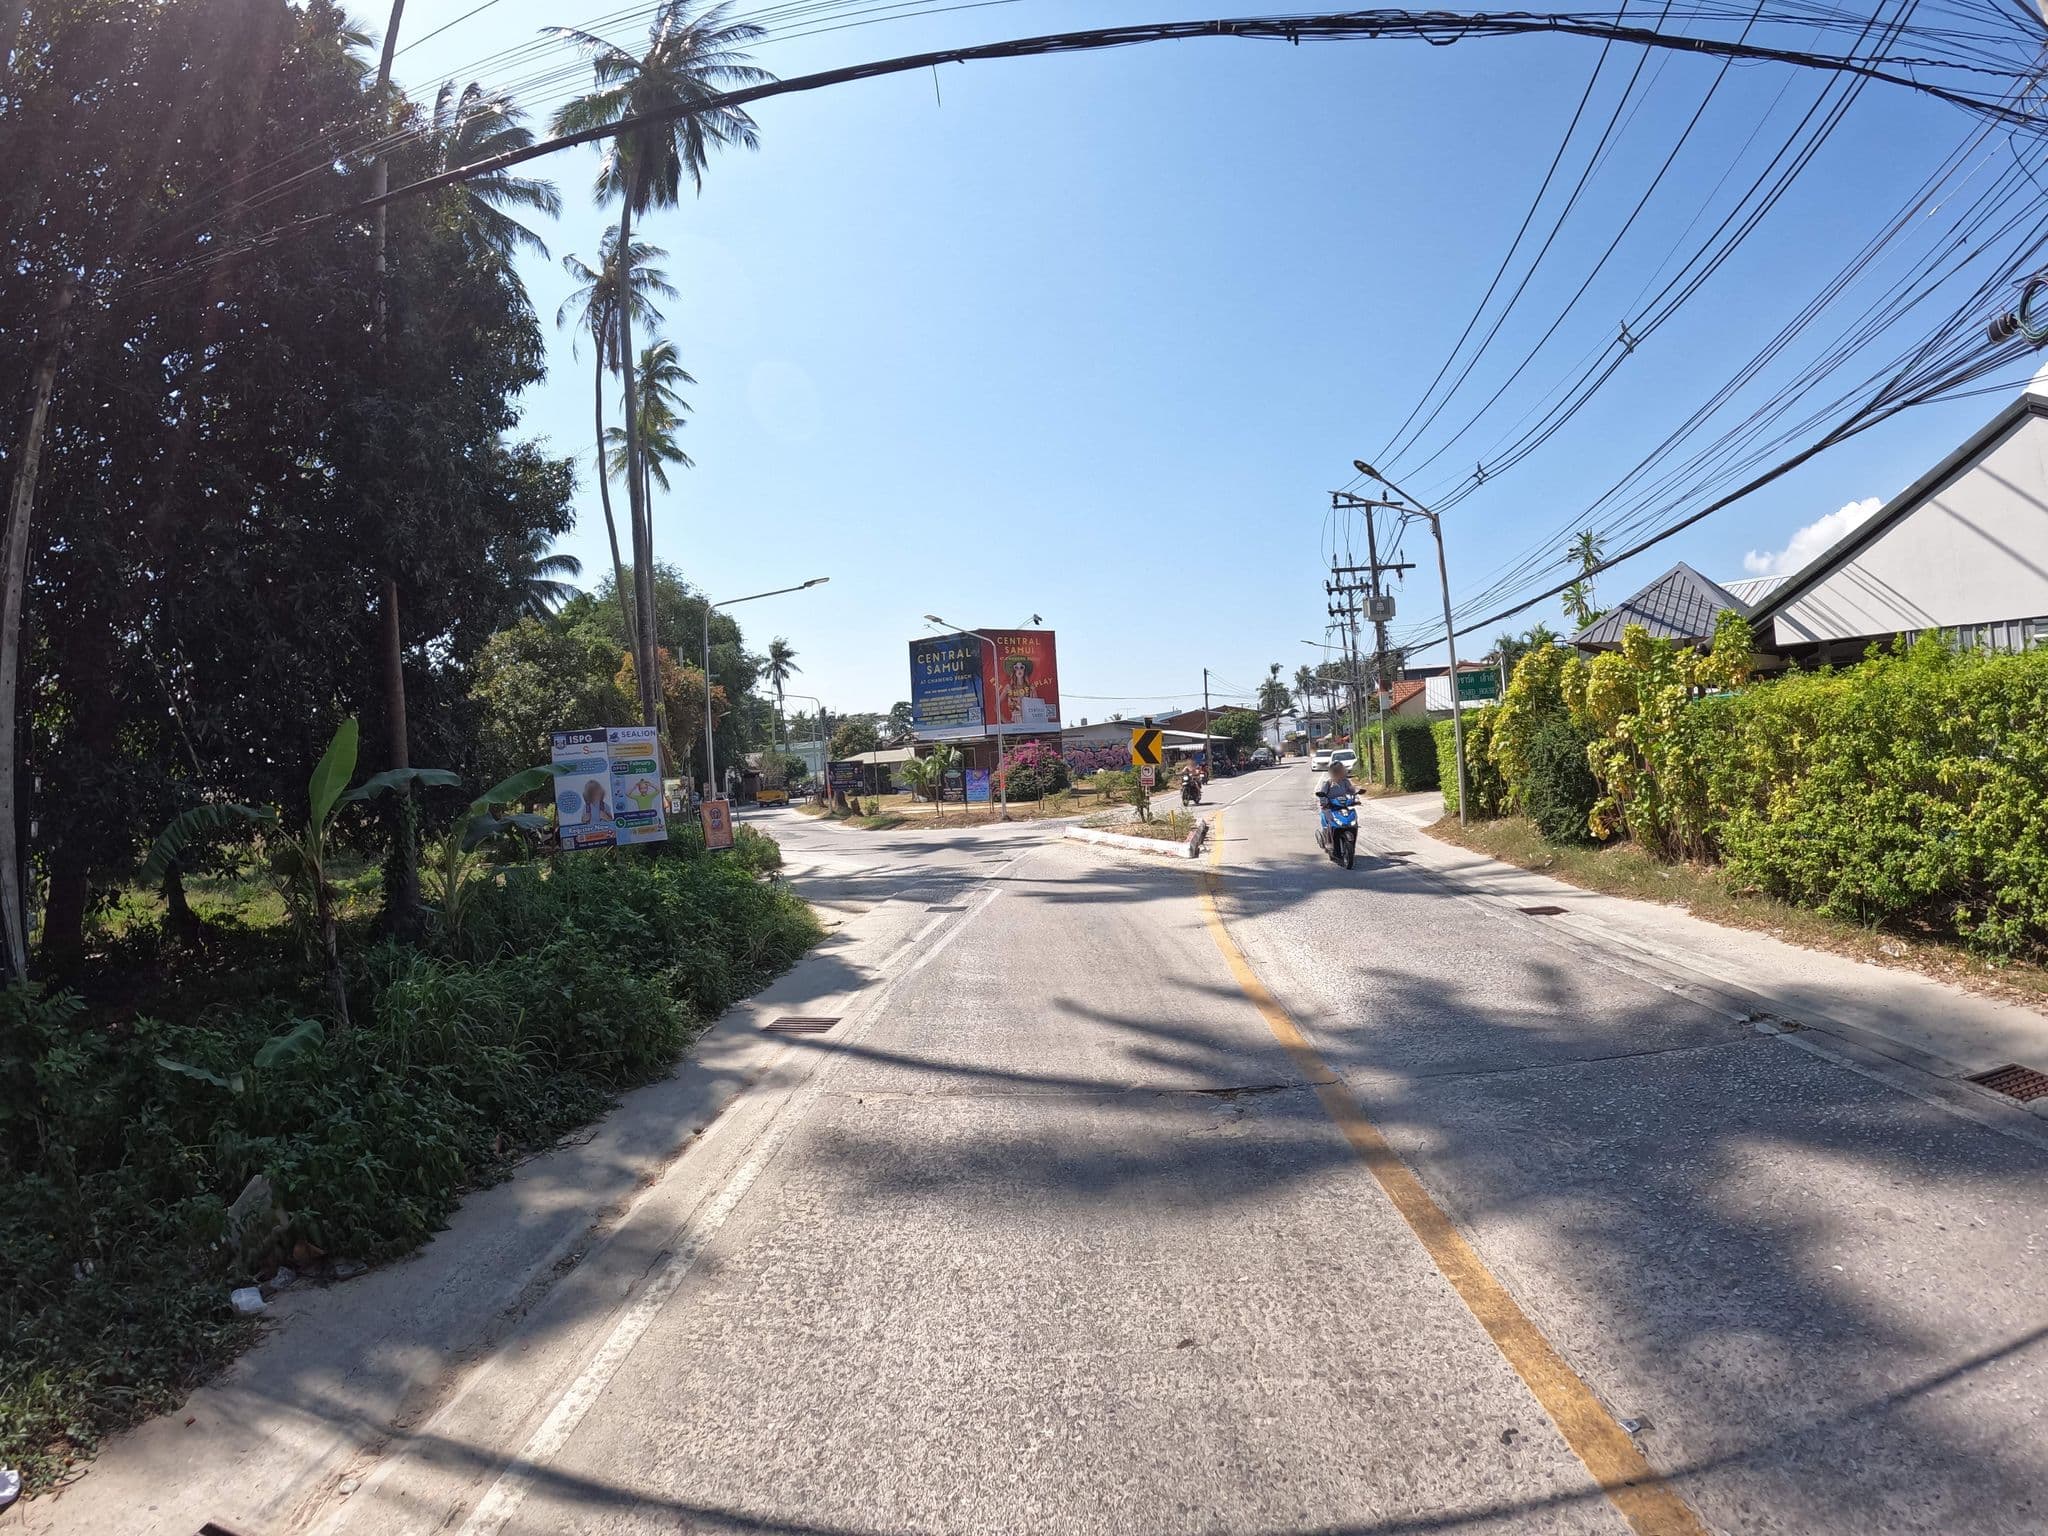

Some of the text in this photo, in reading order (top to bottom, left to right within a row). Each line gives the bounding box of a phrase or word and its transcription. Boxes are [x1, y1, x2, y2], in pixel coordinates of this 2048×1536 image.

[997, 636, 1041, 646] CENTRAL
[917, 648, 972, 664] CENTRAL
[1034, 676, 1053, 688] PLAY
[621, 729, 656, 738] SEALION
[569, 734, 593, 744] ISPG
